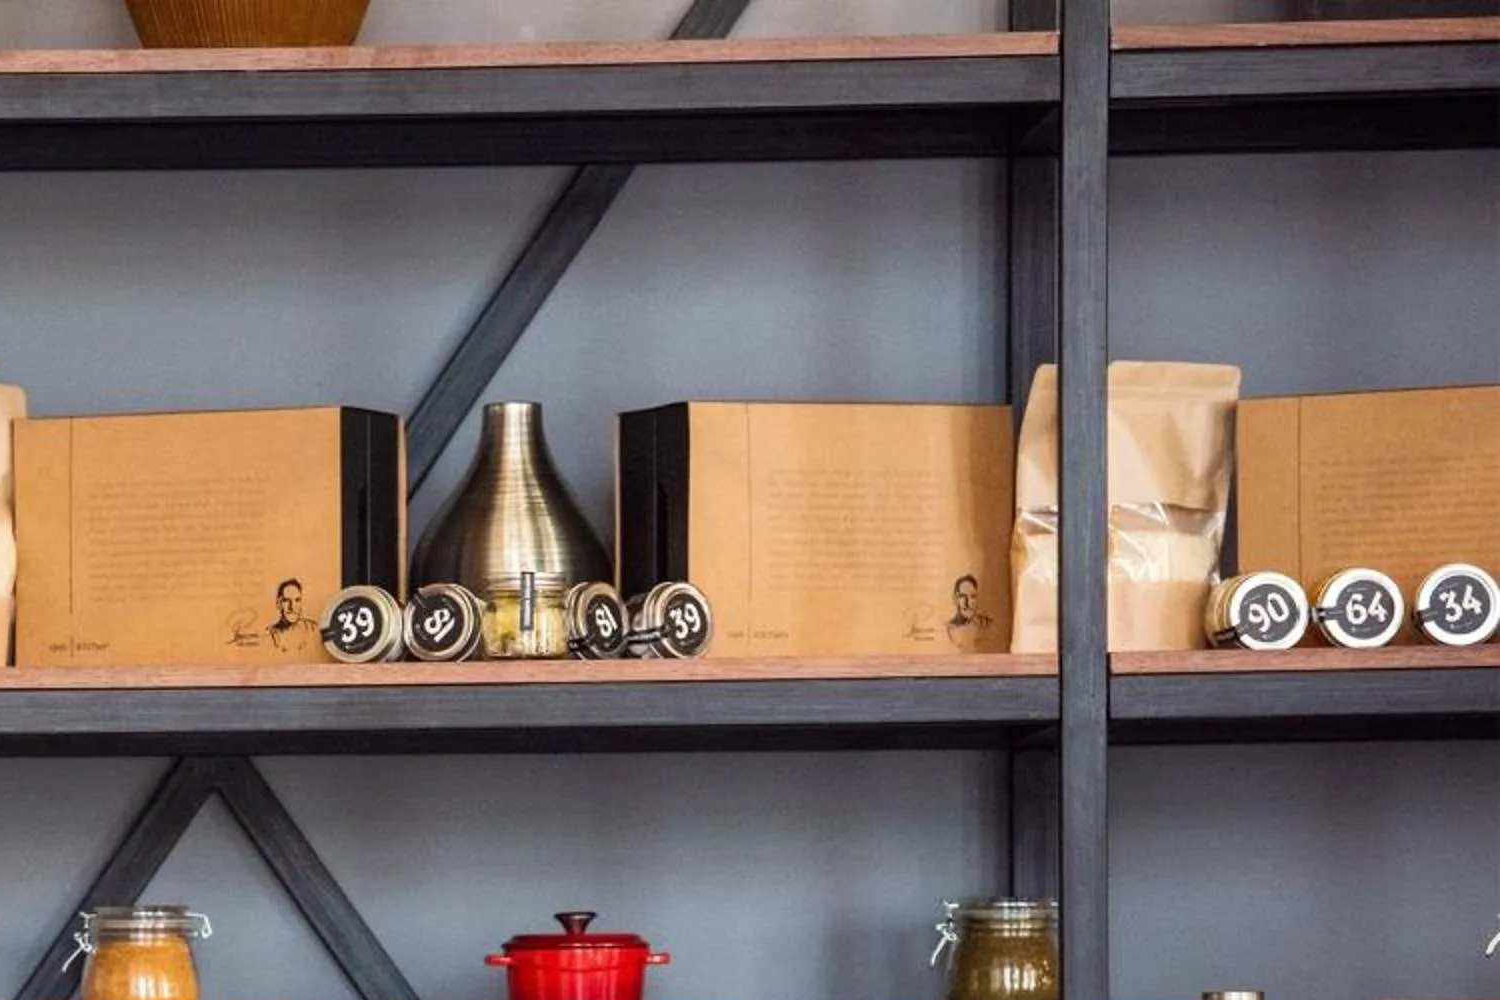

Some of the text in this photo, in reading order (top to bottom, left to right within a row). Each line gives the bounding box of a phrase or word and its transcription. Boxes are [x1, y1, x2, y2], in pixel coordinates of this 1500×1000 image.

[595, 603, 618, 638] 81
[669, 603, 701, 639] 39
[1248, 591, 1290, 633] 90
[1345, 590, 1388, 625] 64
[1439, 584, 1482, 623] 34
[337, 607, 375, 643] 39
